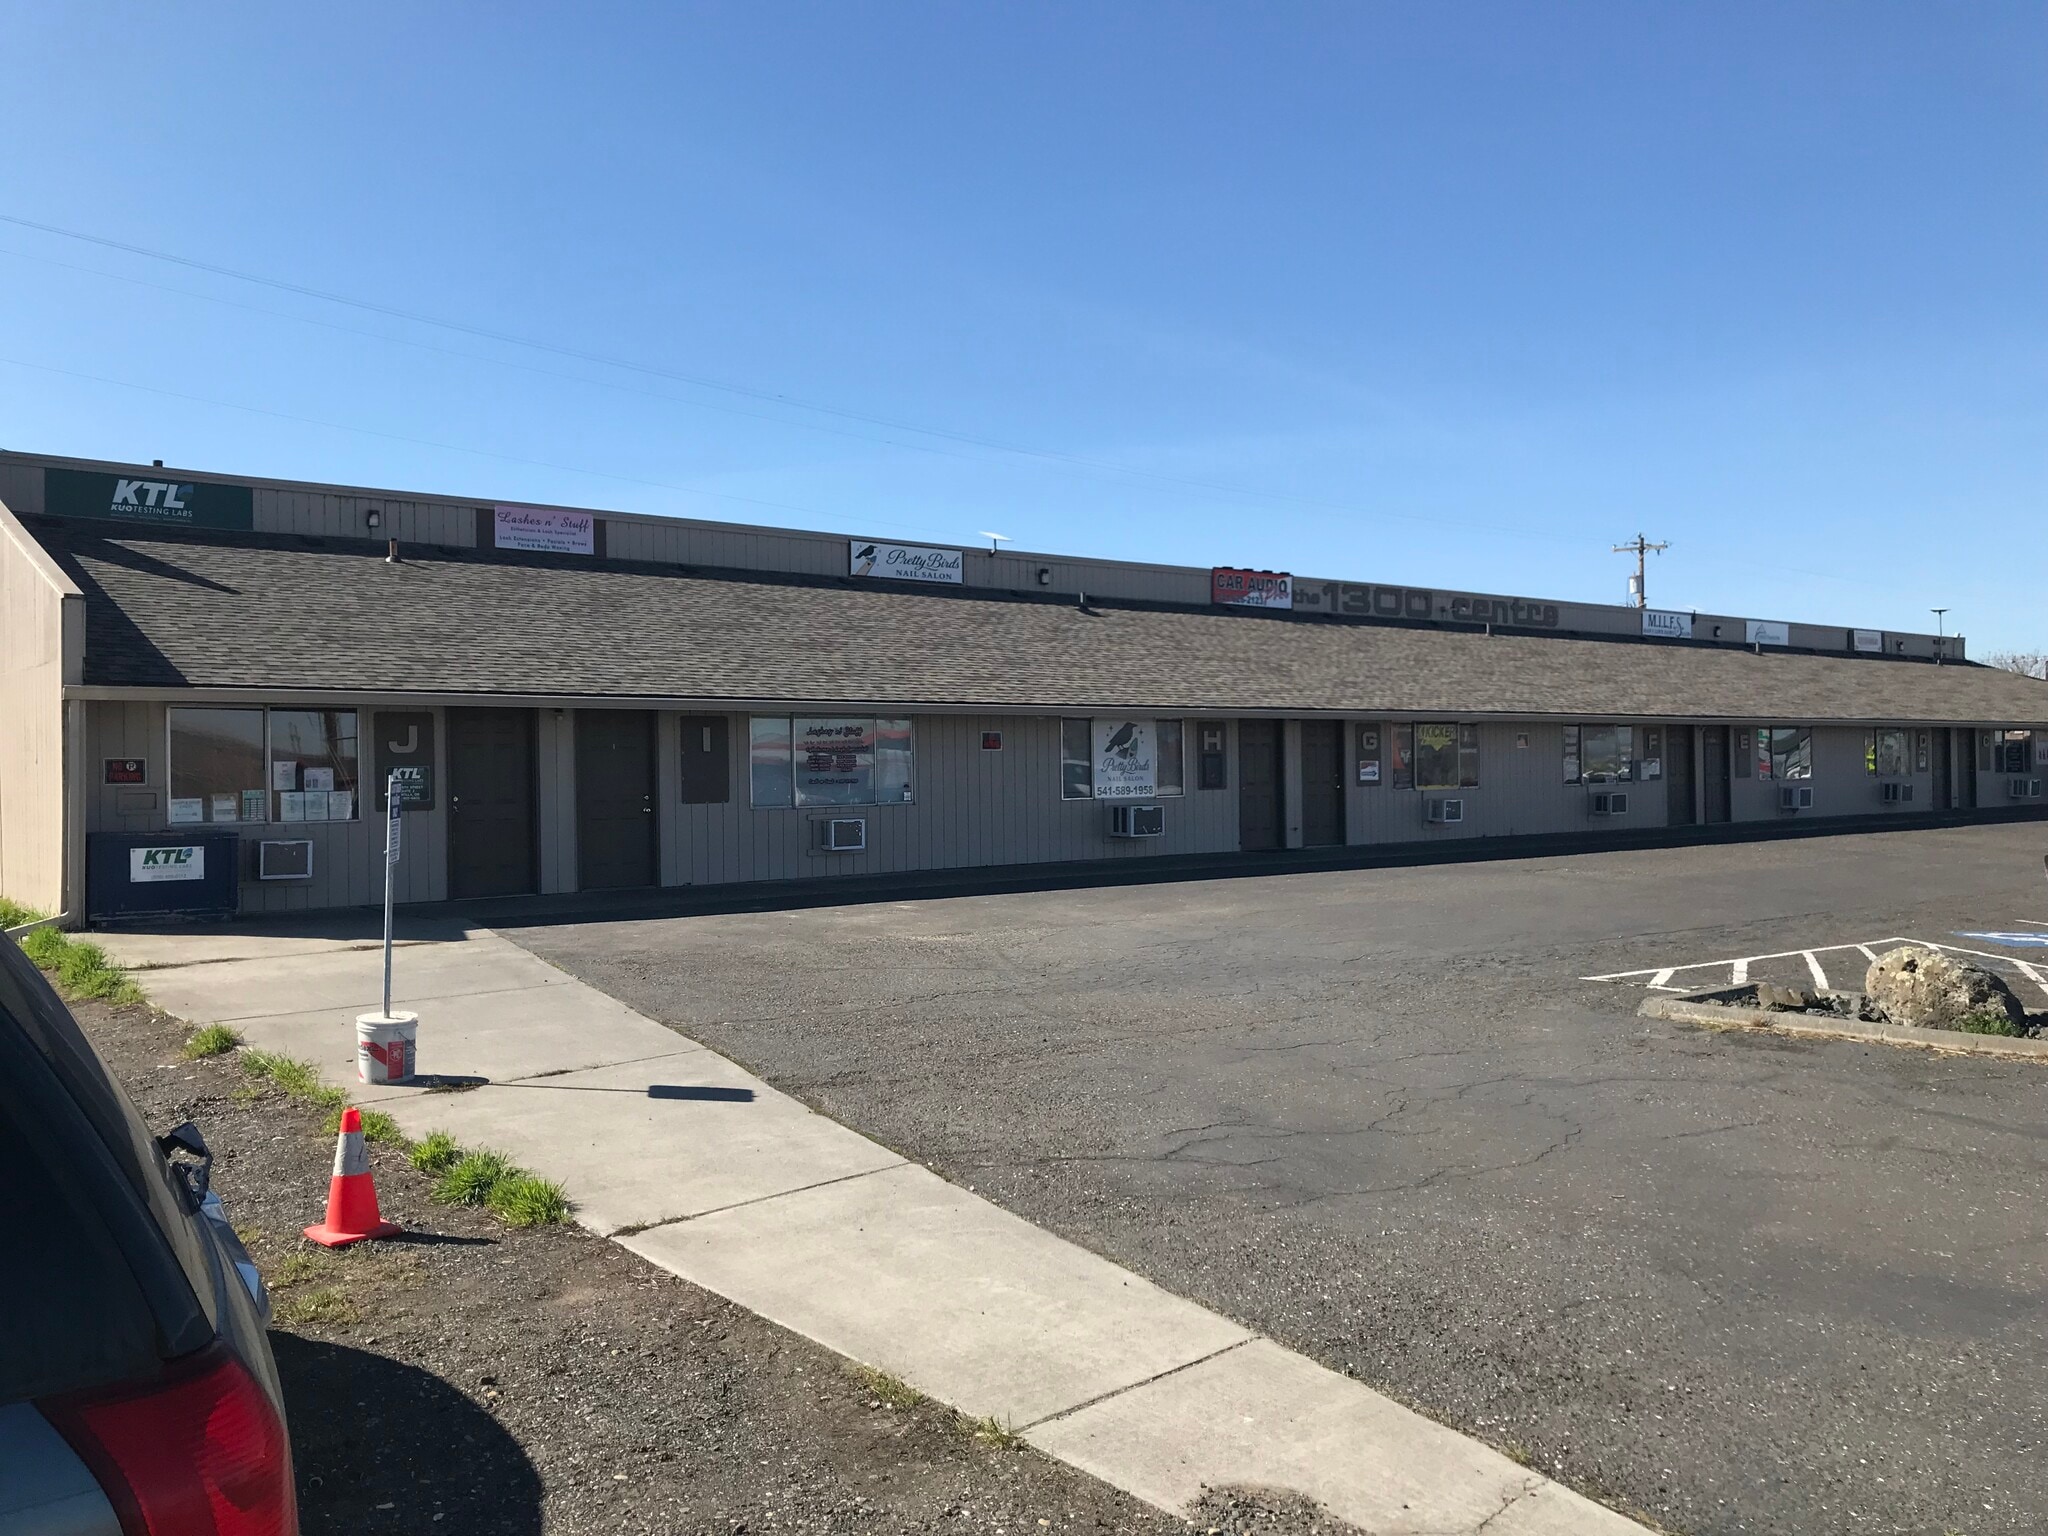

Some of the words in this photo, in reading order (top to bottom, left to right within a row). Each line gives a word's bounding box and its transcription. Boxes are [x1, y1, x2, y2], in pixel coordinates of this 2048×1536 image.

[112, 479, 185, 509] KTL
[172, 509, 193, 517] LABS
[497, 511, 542, 526] Lashes
[560, 516, 590, 533] Stuff
[886, 549, 927, 571] Pretty
[926, 552, 960, 570] Birds
[896, 569, 919, 578] NAIL
[921, 571, 952, 580] SALON
[1217, 574, 1243, 590] CAR
[1247, 576, 1288, 593] AUDIO
[1293, 588, 1320, 604] the
[1322, 582, 1432, 619] 1300
[1452, 597, 1559, 628] centre
[388, 725, 418, 753] J
[702, 726, 711, 752] I
[1203, 730, 1222, 751] H
[1362, 731, 1378, 750] G
[1648, 734, 1658, 750] F
[1740, 734, 1749, 749] E
[392, 767, 421, 779] KTL
[1101, 757, 1128, 776] Pretty
[1127, 757, 1150, 772] Birds
[1097, 785, 1154, 796] 541-589-1958
[143, 848, 187, 865] KTL
